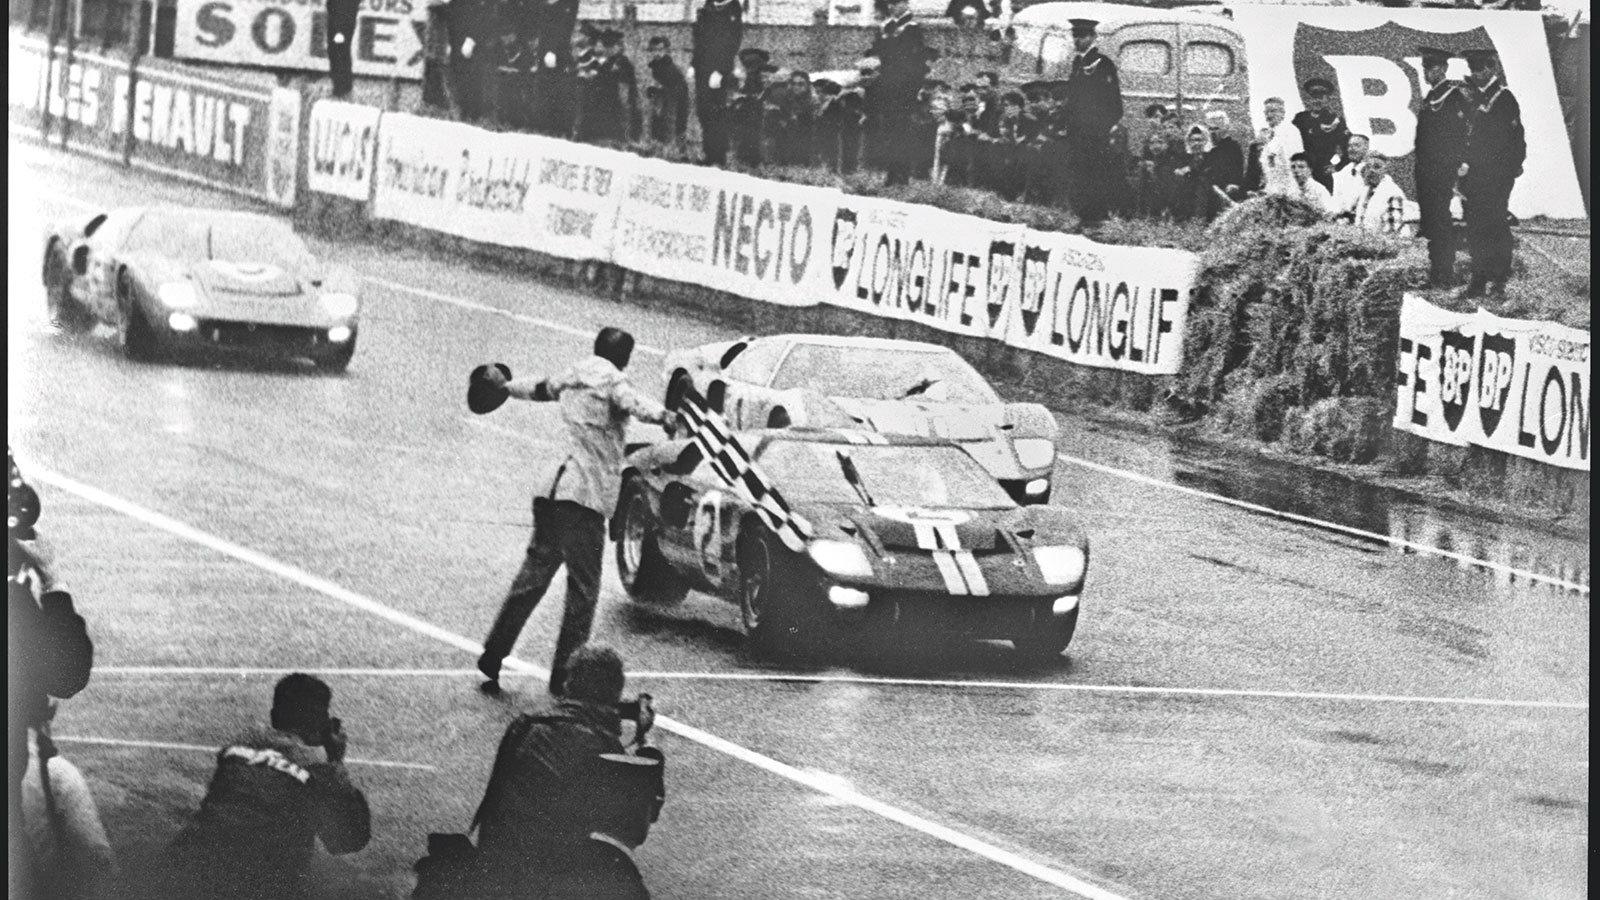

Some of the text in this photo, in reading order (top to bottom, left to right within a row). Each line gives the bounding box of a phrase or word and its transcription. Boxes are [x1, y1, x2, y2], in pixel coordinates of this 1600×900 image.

[712, 190, 812, 284] NECTO
[856, 232, 981, 327] LONGLIFE
[1051, 272, 1179, 364] LONGLIF
[1442, 345, 1472, 406] BP
[1480, 349, 1590, 460] BP LON
